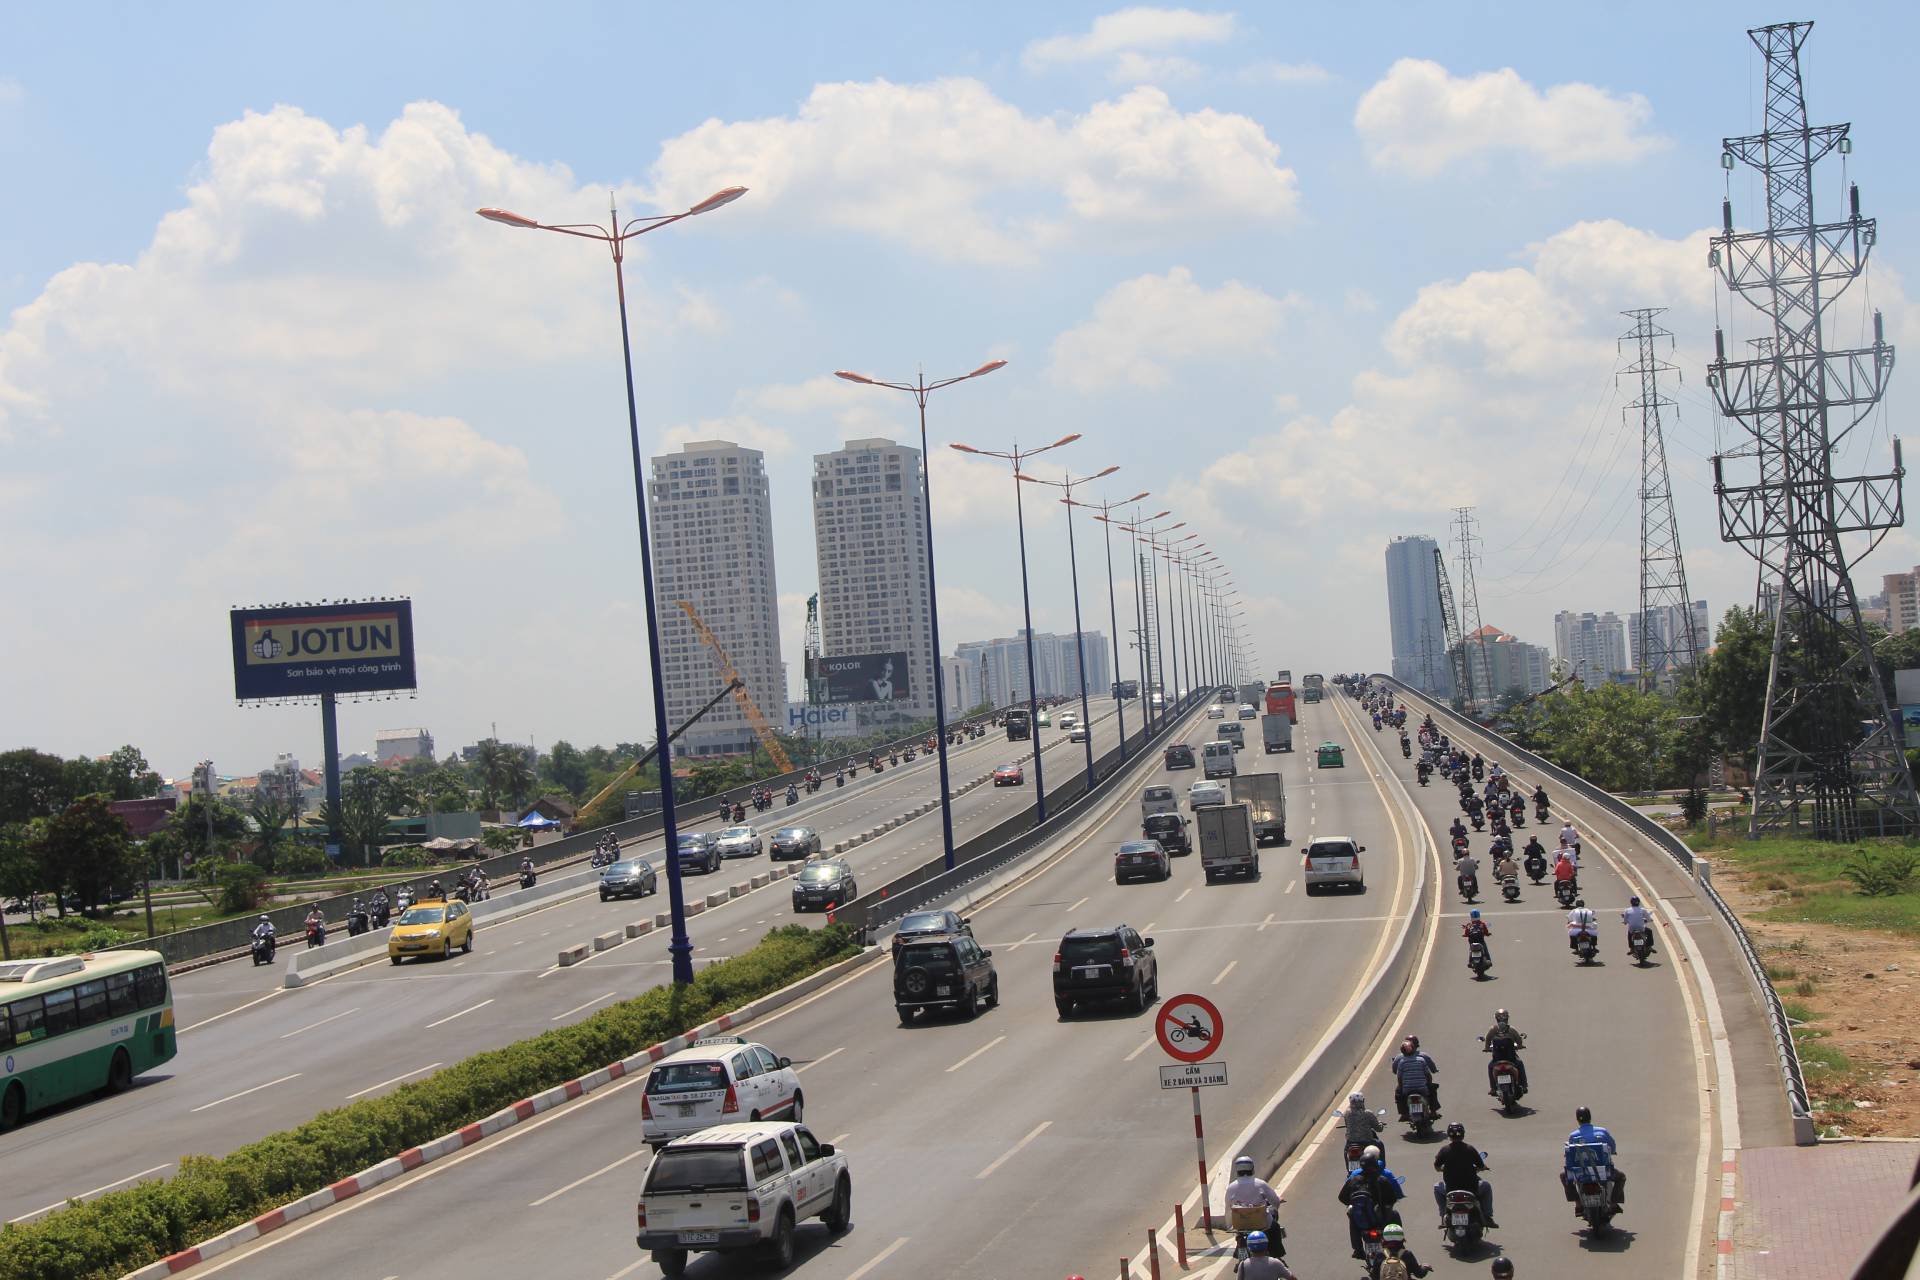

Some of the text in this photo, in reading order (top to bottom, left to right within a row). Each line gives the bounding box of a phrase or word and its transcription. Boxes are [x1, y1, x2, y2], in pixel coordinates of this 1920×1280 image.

[287, 625, 393, 657] JOTUN
[338, 665, 356, 675] mọi
[789, 708, 848, 725] Haier
